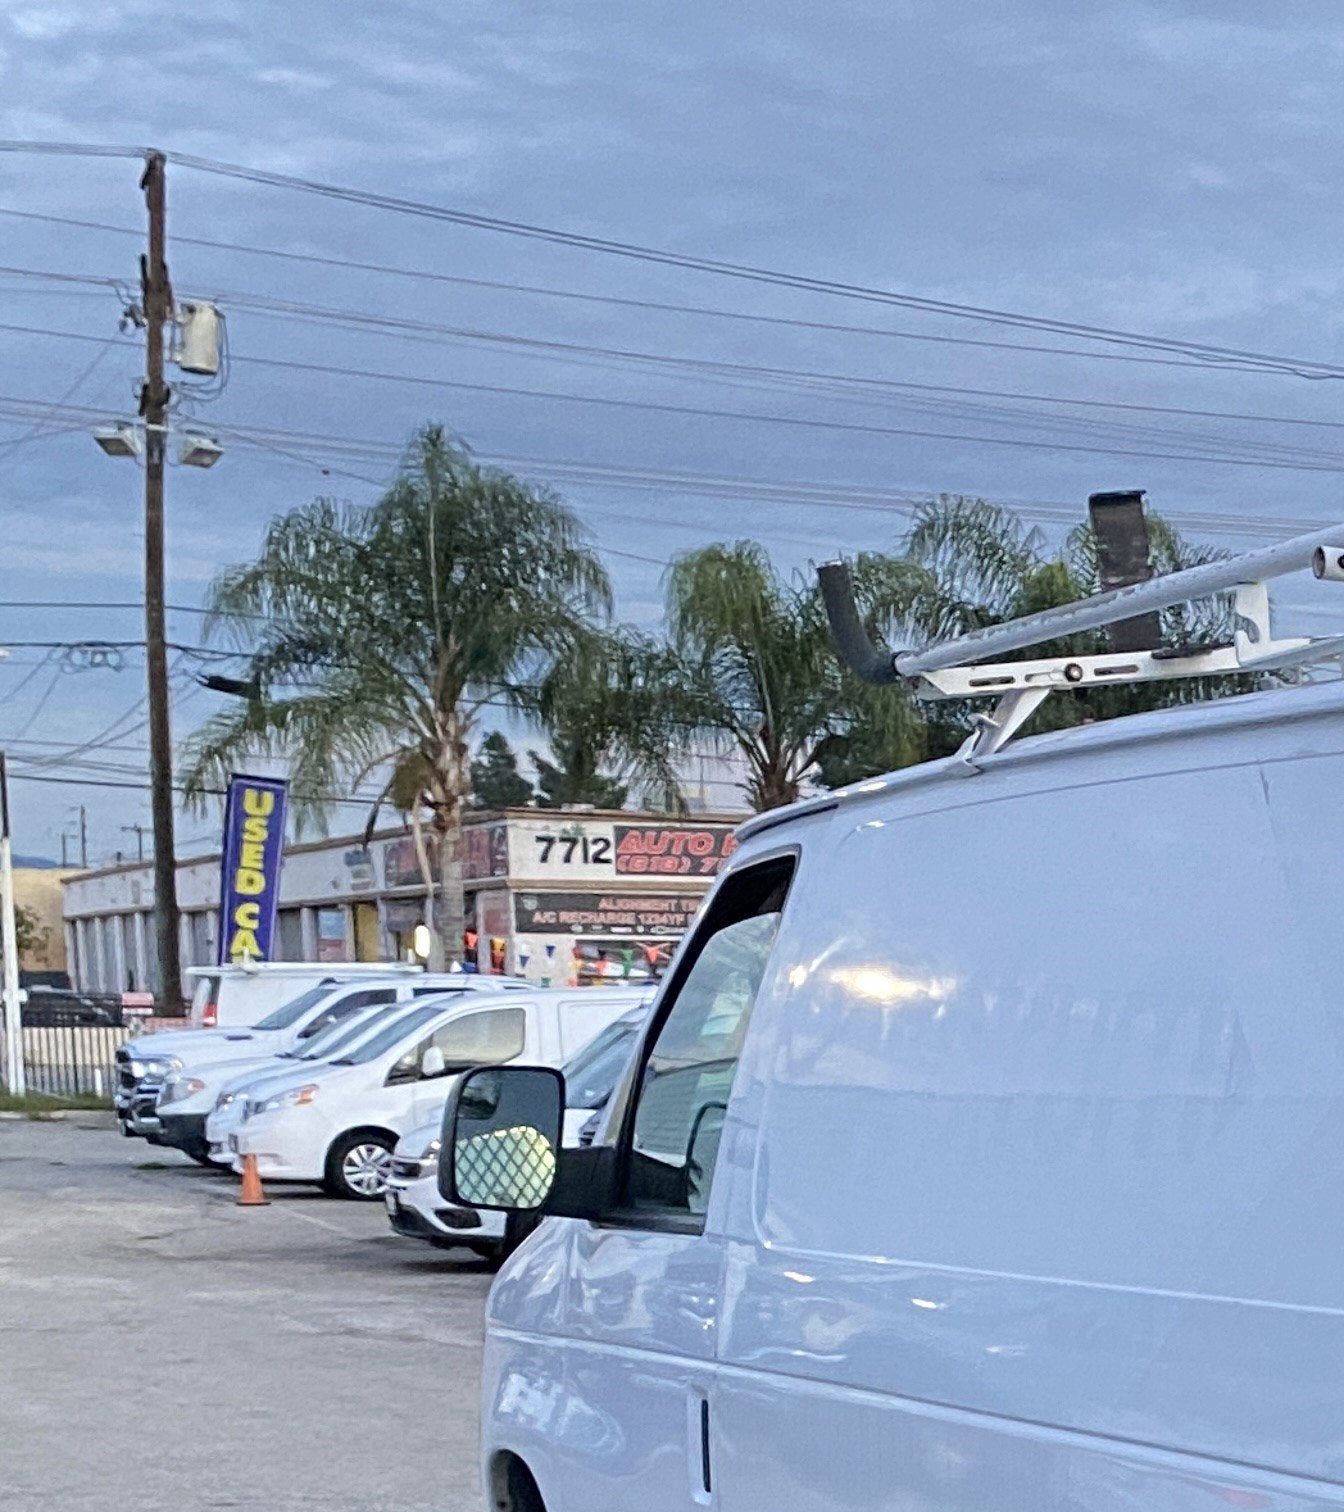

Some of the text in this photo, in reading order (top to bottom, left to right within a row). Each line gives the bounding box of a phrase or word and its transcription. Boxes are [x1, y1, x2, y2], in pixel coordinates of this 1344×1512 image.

[235, 788, 275, 896] USED
[535, 835, 613, 864] 7712
[617, 829, 715, 855] AUTO
[532, 911, 557, 922] A/C
